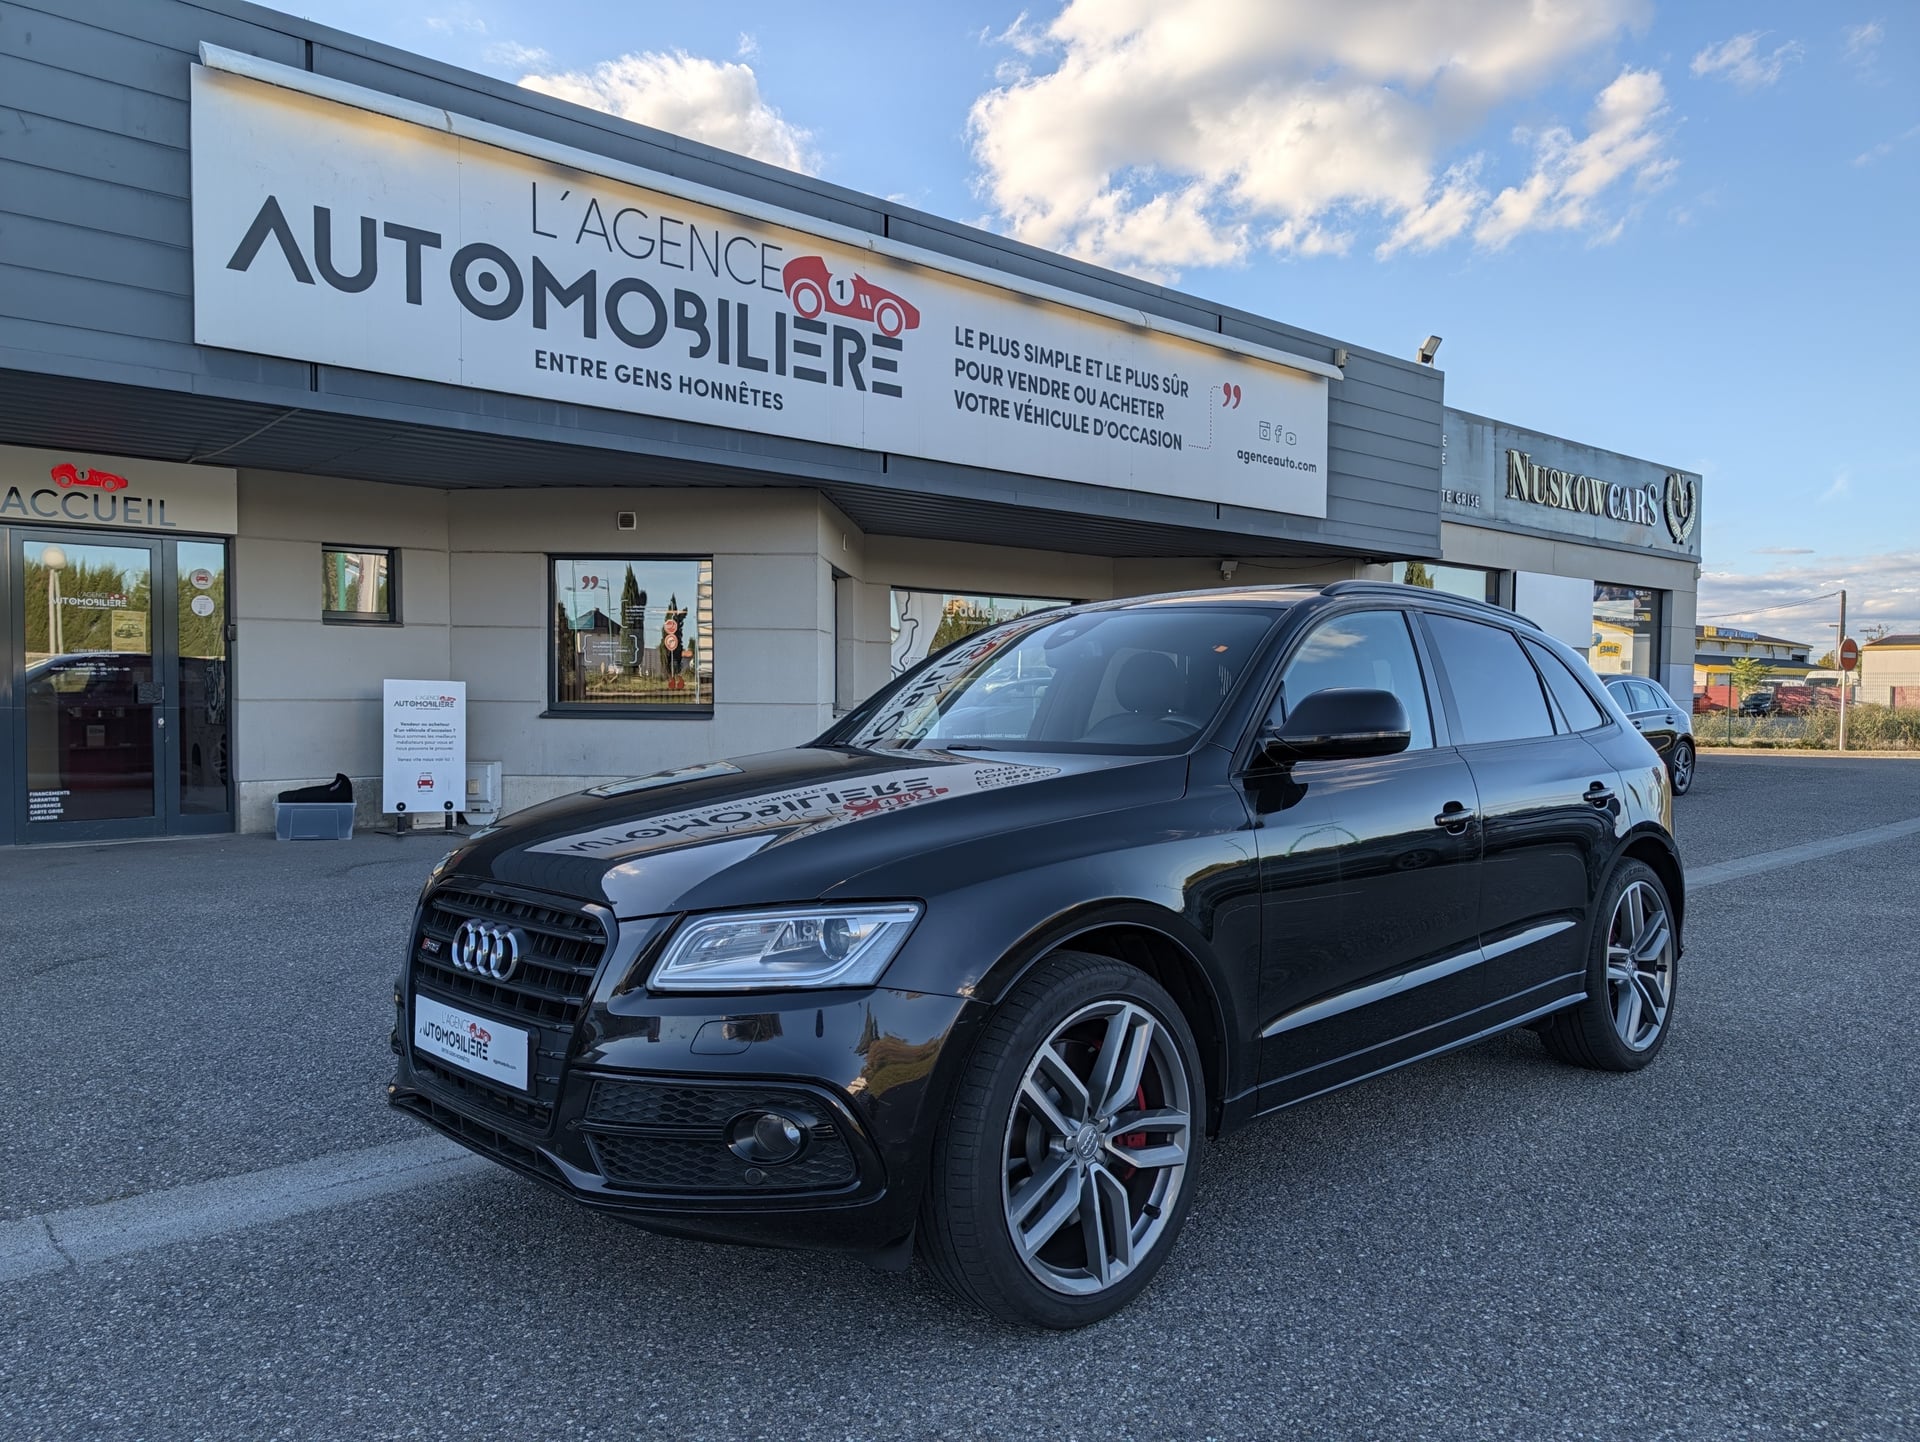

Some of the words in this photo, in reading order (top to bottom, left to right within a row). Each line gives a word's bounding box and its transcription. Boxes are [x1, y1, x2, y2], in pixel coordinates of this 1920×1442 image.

[532, 182, 784, 294] L'AGENCE
[535, 349, 608, 380] ENTRE
[615, 364, 672, 391] GENS
[680, 376, 784, 411] HONNÊTES
[954, 358, 1003, 387] POUR
[1008, 370, 1070, 400] VENDRE
[1074, 384, 1097, 406] OU
[1099, 389, 1165, 420] ACHETER
[955, 326, 974, 350] LE
[979, 332, 1020, 360] PLUS
[1024, 343, 1081, 373] SIMPLE
[1086, 357, 1103, 378] ET
[1106, 361, 1122, 383] LE
[1126, 368, 1160, 392] PLUS
[1162, 374, 1189, 398] SÛR
[954, 390, 1010, 419] VOTRE
[1013, 399, 1089, 434] VÉHICULE
[1093, 418, 1182, 451] D'OCCASION
[1237, 448, 1317, 473] agenceauto.com
[0, 486, 177, 527] ACCUEIL
[1456, 492, 1480, 508] GRISE
